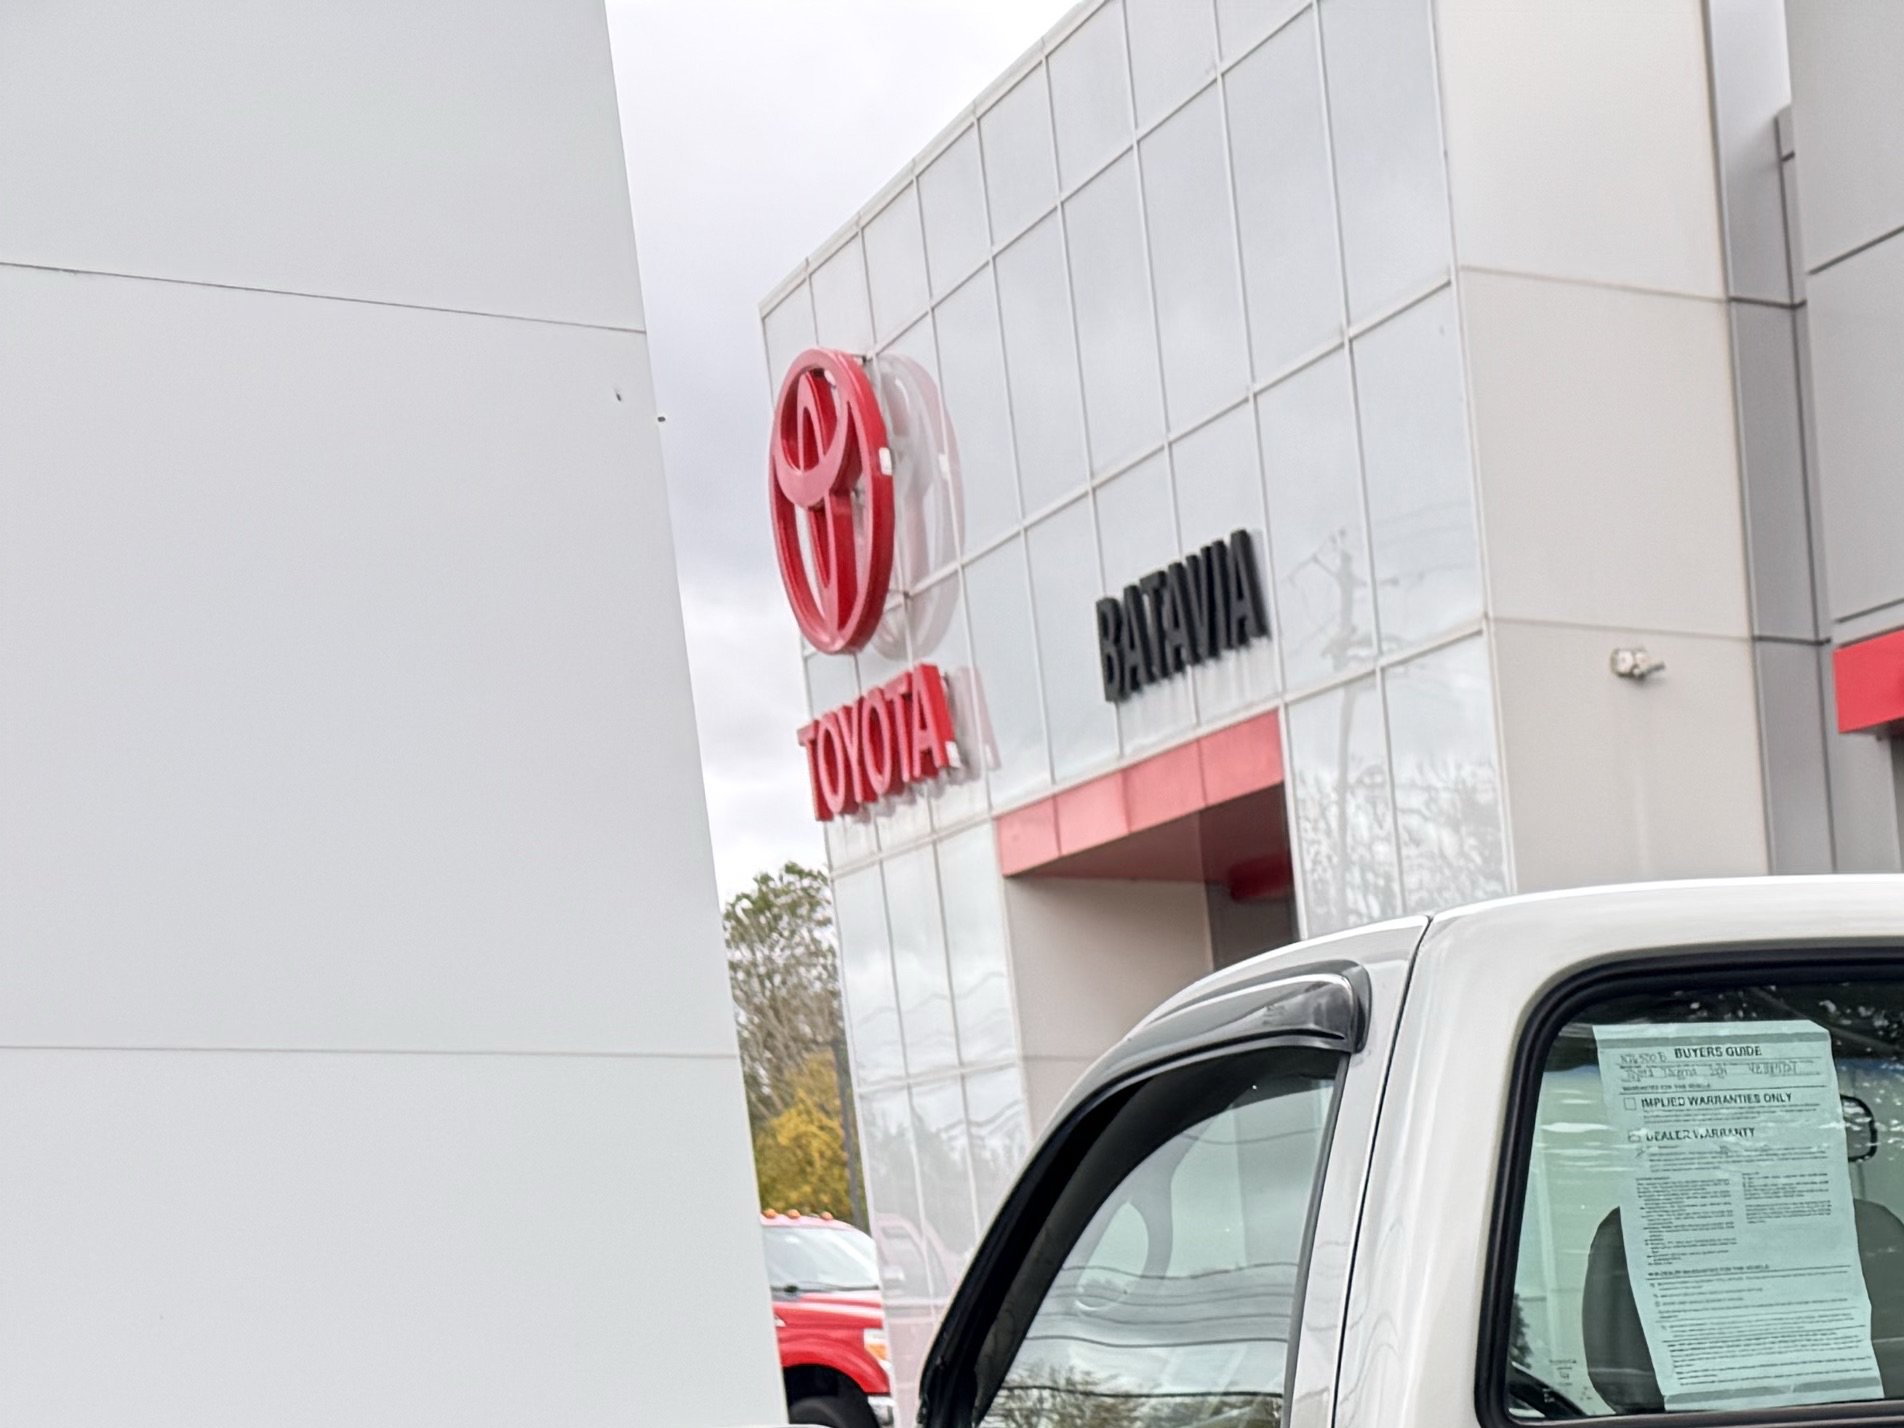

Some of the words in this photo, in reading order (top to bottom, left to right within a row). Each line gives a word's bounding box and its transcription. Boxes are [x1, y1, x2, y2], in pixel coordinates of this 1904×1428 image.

[1096, 529, 1270, 702] BATAVIA
[798, 663, 958, 822] TOYOTA
[1674, 1046, 1723, 1059] BUYERS
[1725, 1045, 1762, 1057] GUIDE
[1641, 1096, 1685, 1108] IMPLIED
[1687, 1094, 1761, 1107] WARRANTIES
[1764, 1092, 1792, 1104] ONLY
